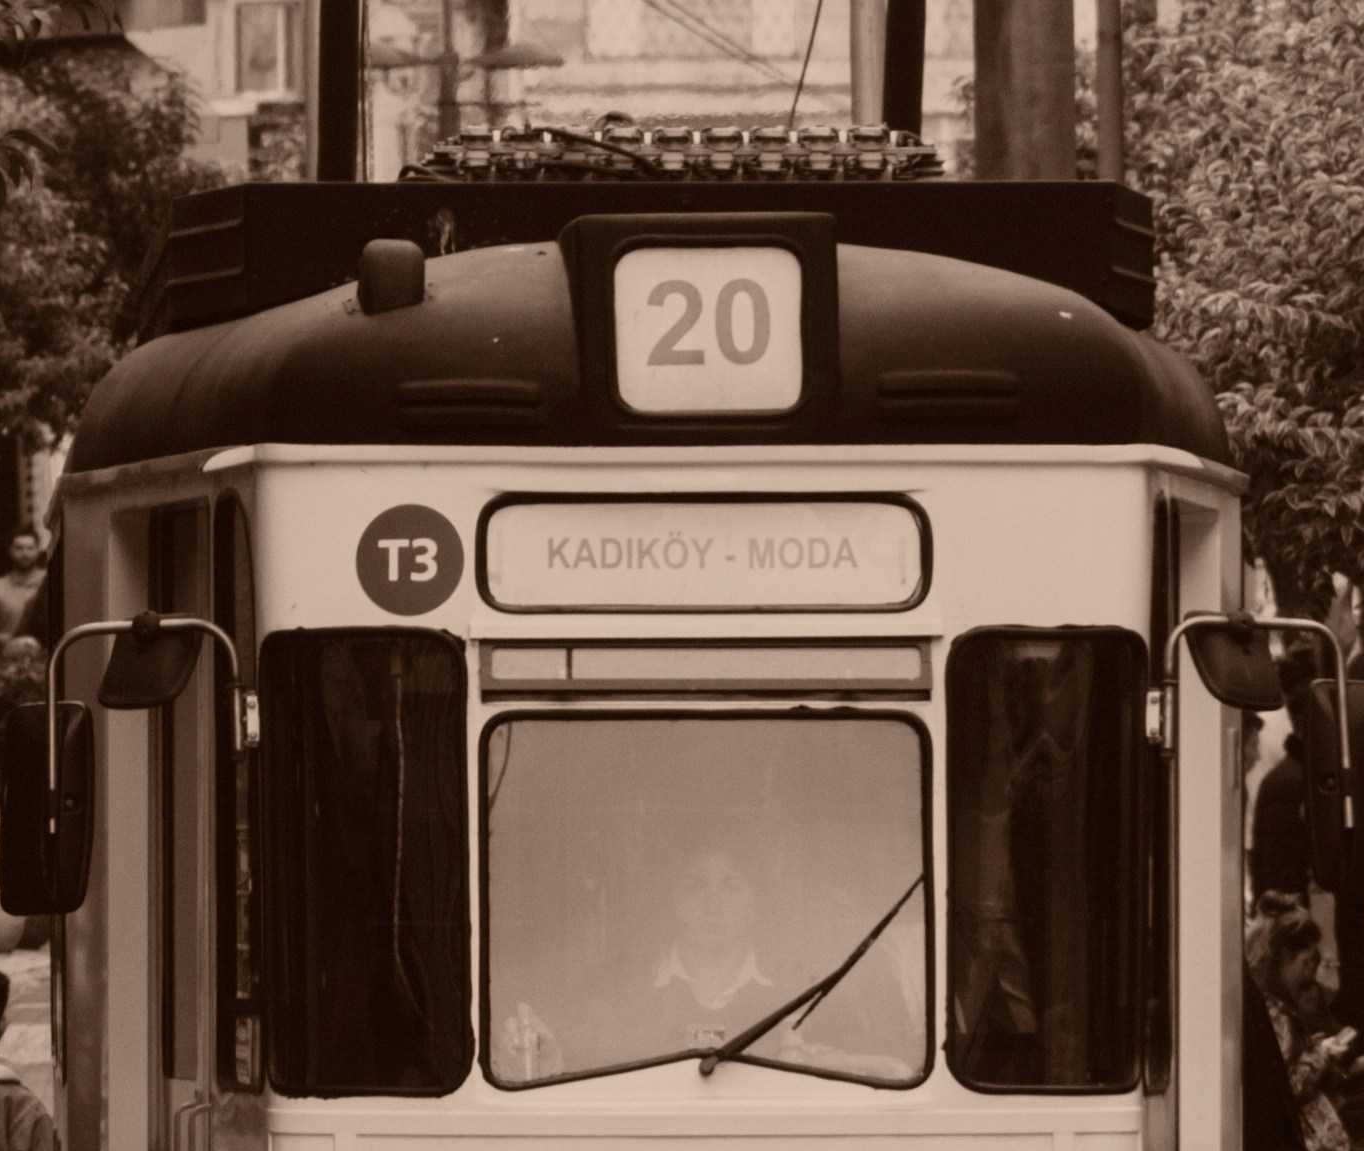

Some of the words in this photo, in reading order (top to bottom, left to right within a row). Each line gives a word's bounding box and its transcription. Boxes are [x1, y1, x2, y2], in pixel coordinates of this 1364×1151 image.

[646, 277, 771, 367] 20
[377, 538, 438, 582] T3
[546, 531, 714, 570] KADIKÖY
[747, 537, 859, 570] MODA
